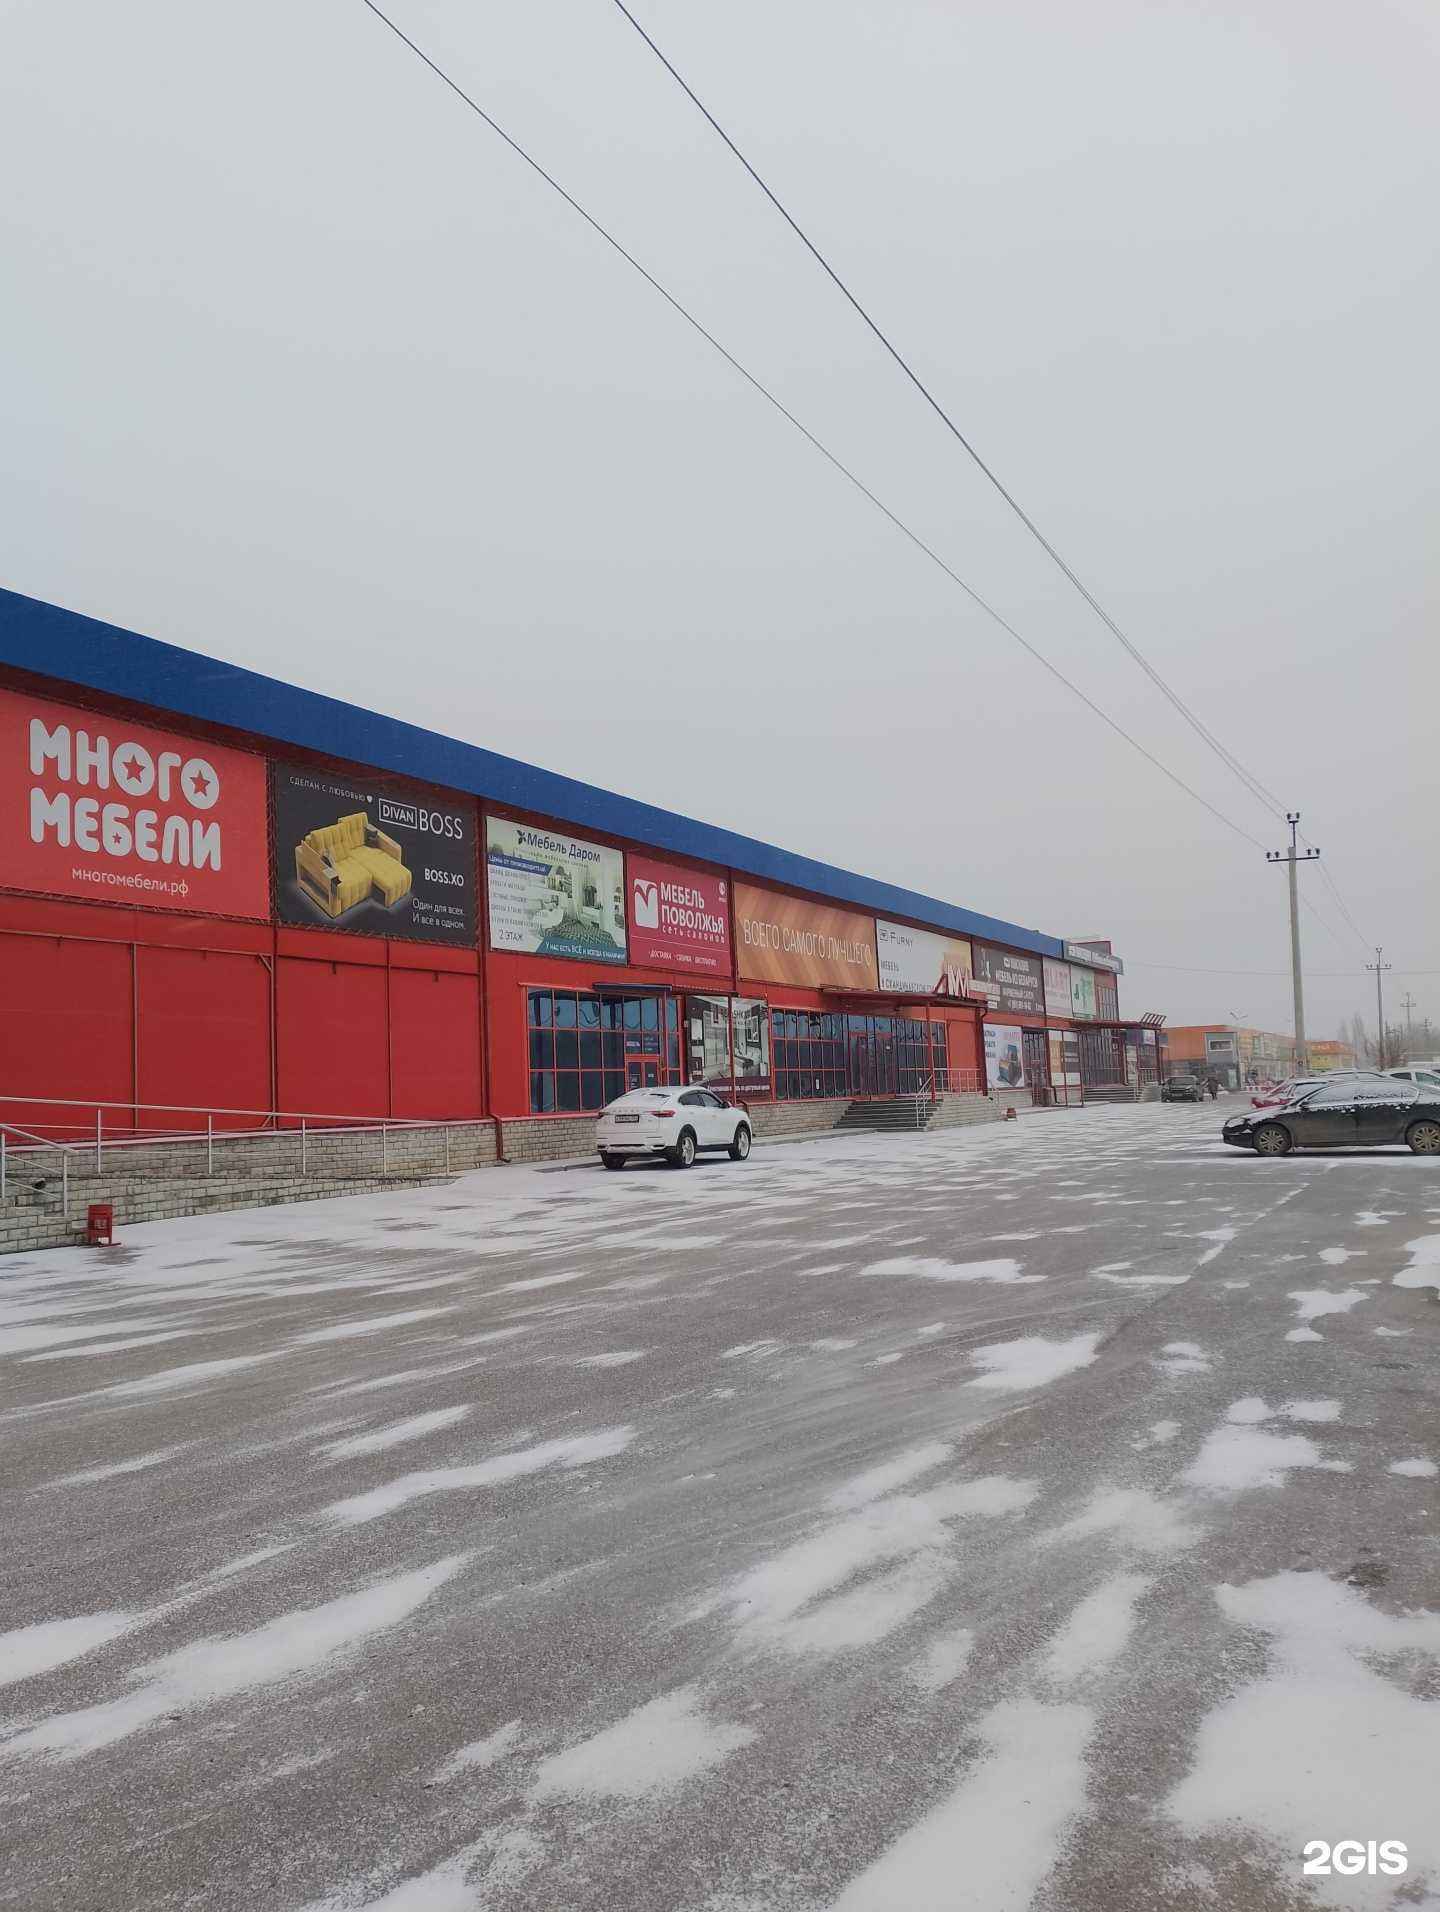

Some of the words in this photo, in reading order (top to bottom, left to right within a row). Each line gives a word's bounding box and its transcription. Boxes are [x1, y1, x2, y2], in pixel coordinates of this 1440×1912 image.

[29, 718, 220, 810] МНОГО
[289, 776, 320, 790] СДЕЛАН
[329, 786, 366, 801] ЛЮБОВЬЮ
[29, 787, 222, 872] МЕБЕЛИ
[382, 804, 415, 824] DIVAN
[419, 809, 463, 840] BOSS
[526, 832, 567, 854] Мебель
[568, 843, 601, 863] Даром
[72, 868, 189, 897] многомебели.рф
[424, 868, 464, 887] BOSS.XO
[412, 897, 433, 911] Один
[434, 904, 447, 913] для
[660, 881, 705, 909] МЕБЕЛЬ
[412, 912, 420, 923] И
[661, 904, 725, 934] ПОВОЛЖЬЯ
[743, 919, 780, 950] ВСЕГО
[782, 927, 826, 958] САМОГО
[827, 936, 871, 966] ЛУЧШЕГО
